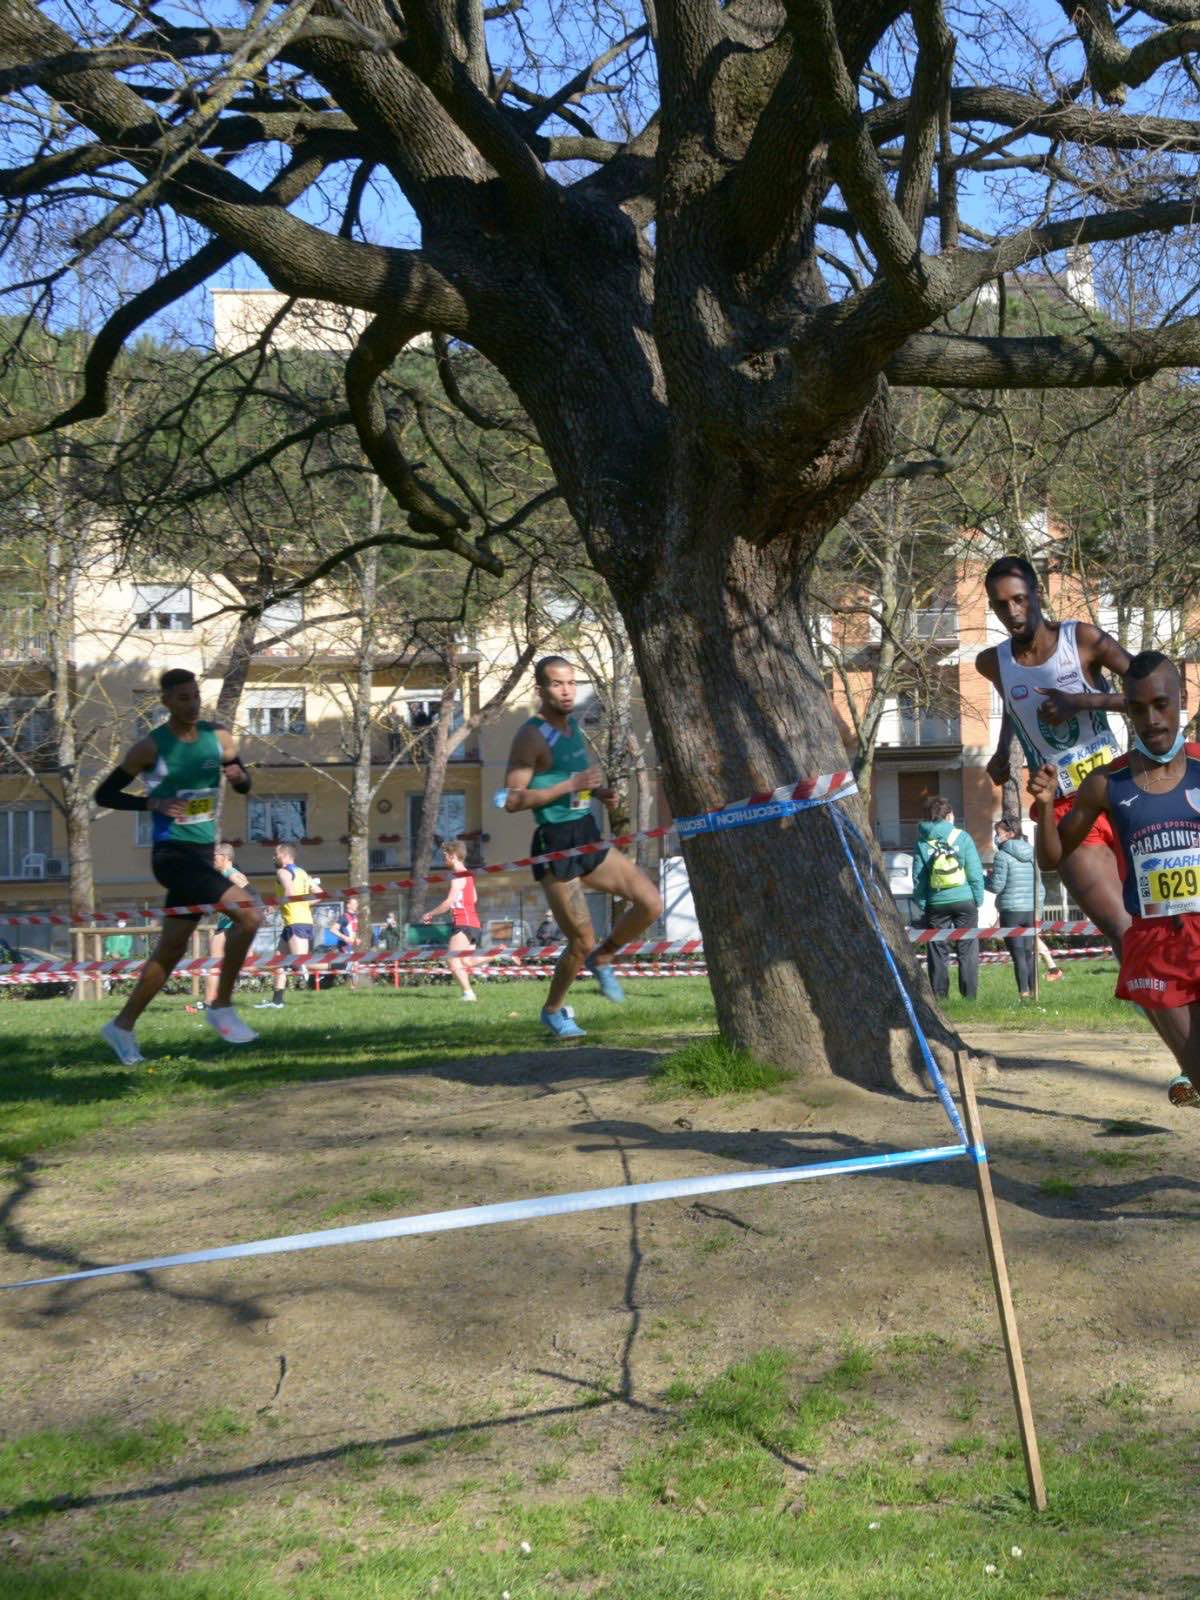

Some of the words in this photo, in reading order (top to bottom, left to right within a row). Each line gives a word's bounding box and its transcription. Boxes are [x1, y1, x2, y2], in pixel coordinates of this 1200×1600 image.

[1076, 735, 1110, 759] KARHU
[716, 804, 783, 826] DECATHLON
[1164, 820, 1200, 830] SPORTIVO
[1158, 869, 1198, 899] 629
